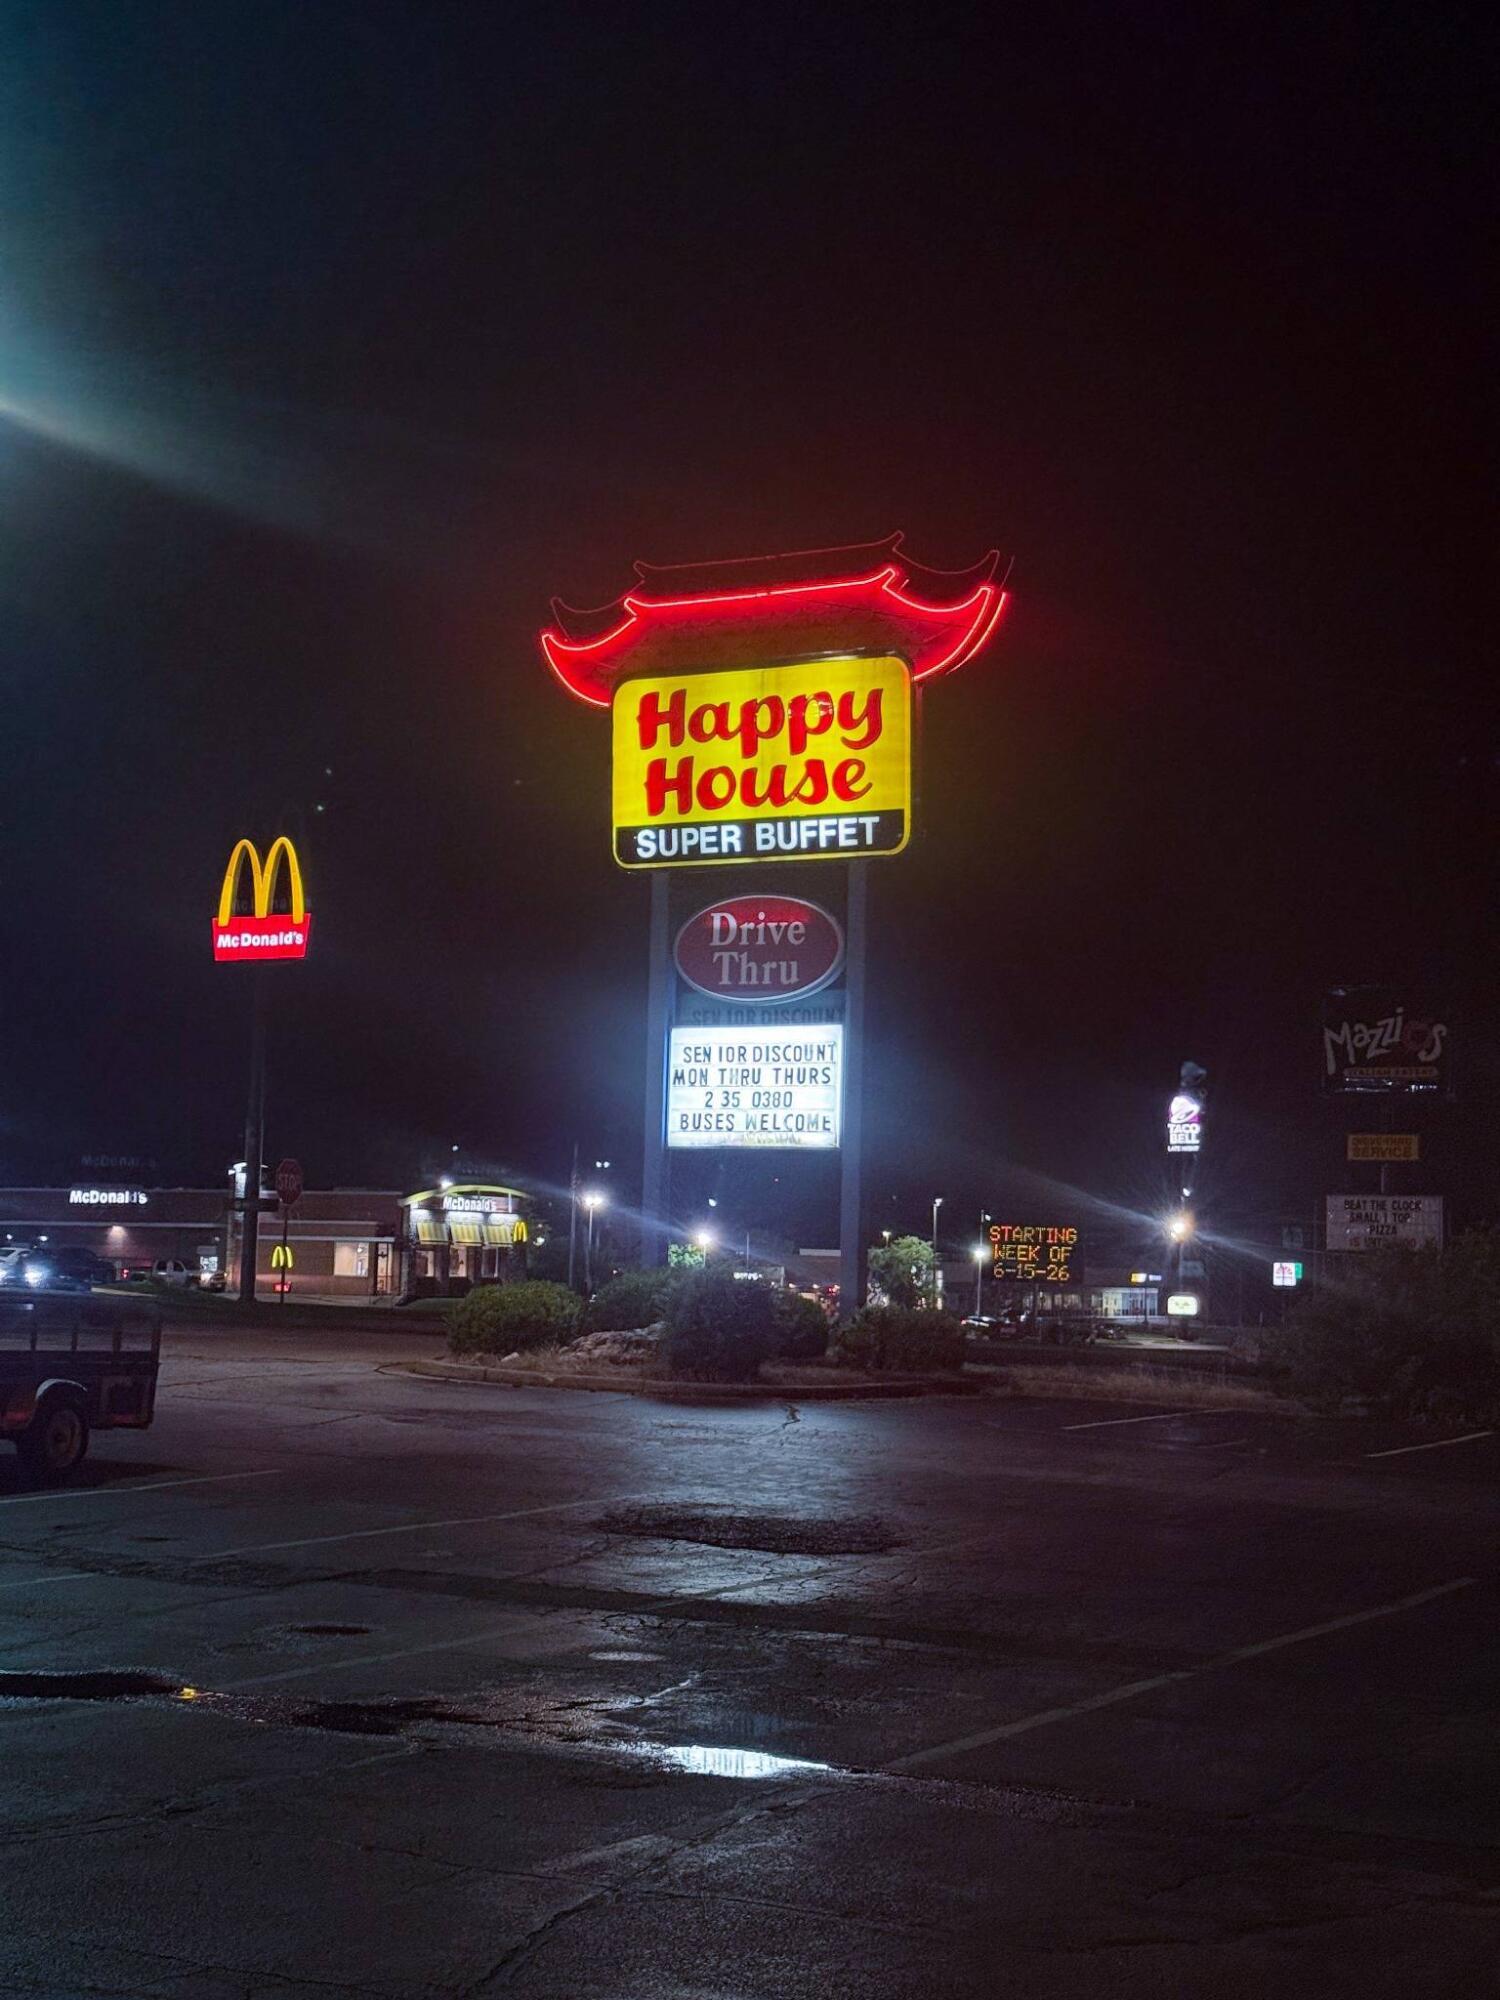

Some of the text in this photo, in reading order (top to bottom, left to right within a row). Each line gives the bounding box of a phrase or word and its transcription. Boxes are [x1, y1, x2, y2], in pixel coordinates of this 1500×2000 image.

[637, 687, 883, 759] Happy
[645, 757, 873, 817] House
[636, 816, 881, 858] SUPER BUFFET
[709, 911, 806, 947] Drive
[216, 931, 305, 949] McDonald's
[712, 951, 800, 986] Thru
[753, 1044, 837, 1063] DISCOUNT
[672, 1067, 832, 1086] MON THRU THURS
[752, 1091, 793, 1108] 0380
[680, 1113, 832, 1131] BUSES WELCOME
[1167, 1123, 1201, 1134] TACO
[1169, 1133, 1200, 1145] BELL
[1352, 1146, 1413, 1158] SERVICE
[69, 1189, 148, 1205] McDonald's
[443, 1196, 497, 1212] McDonald's
[1369, 1199, 1387, 1211] THE
[1391, 1199, 1423, 1212] CLOCK
[1392, 1212, 1411, 1223] TOP
[989, 1225, 1078, 1244] STARTING
[1369, 1224, 1398, 1236] PIZZA
[992, 1243, 1073, 1262] WEEK OF
[993, 1262, 1070, 1281] 6-15-26
